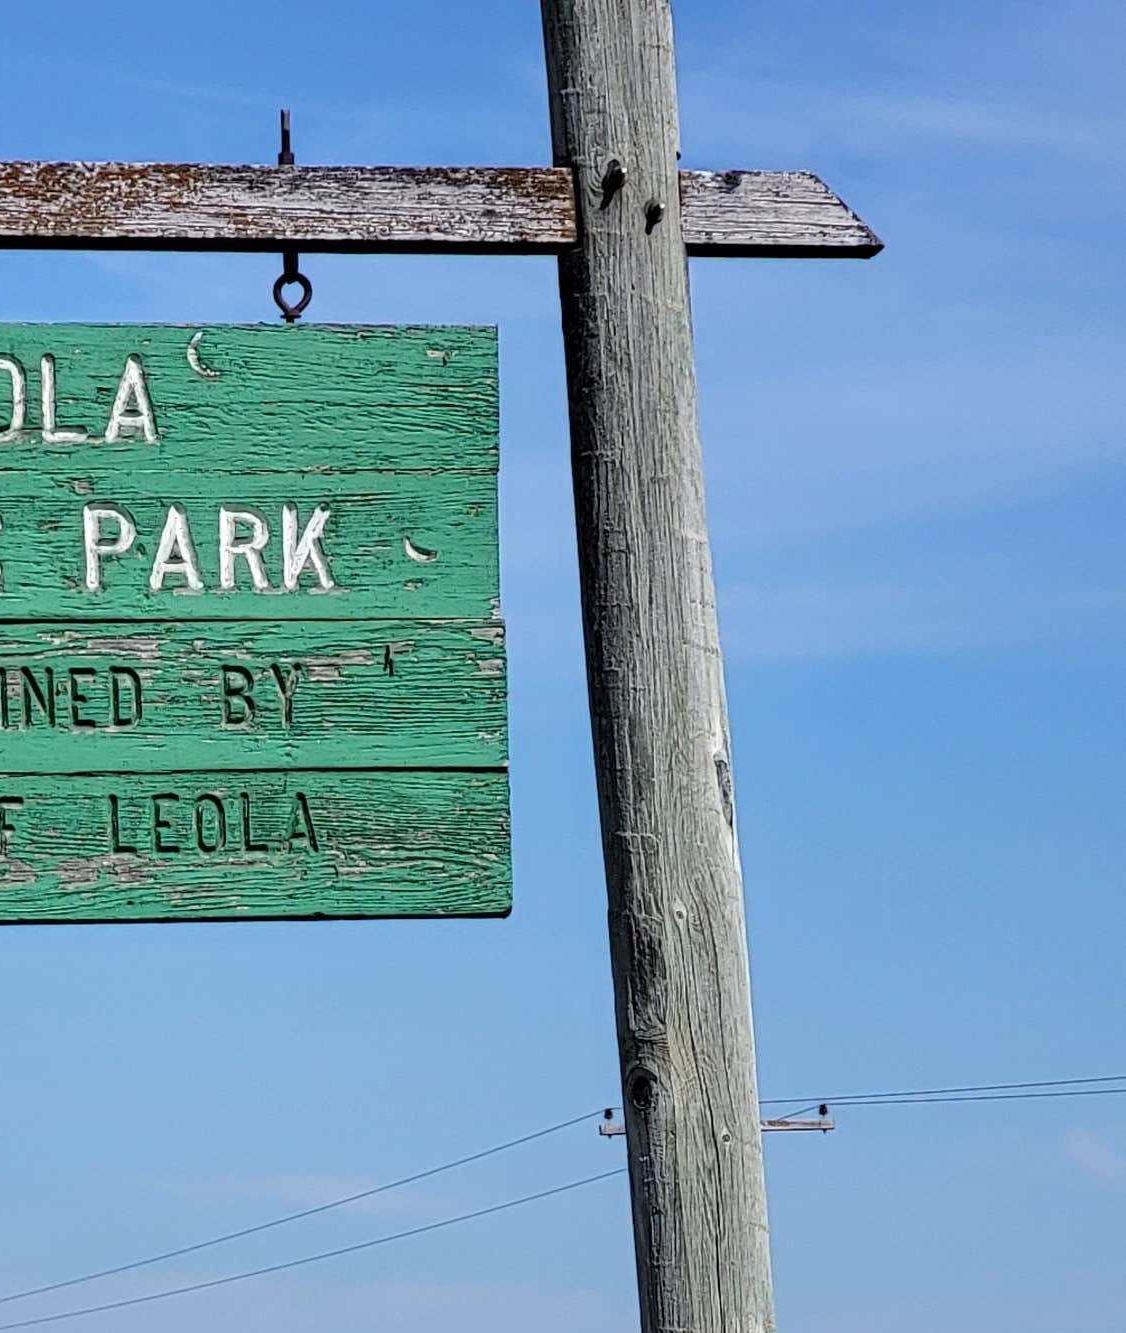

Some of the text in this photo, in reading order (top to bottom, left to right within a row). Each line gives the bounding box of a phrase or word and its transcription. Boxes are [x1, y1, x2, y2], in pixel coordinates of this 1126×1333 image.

[81, 502, 339, 592] PARK
[219, 662, 305, 732] BY
[107, 790, 320, 854] LEOLA
